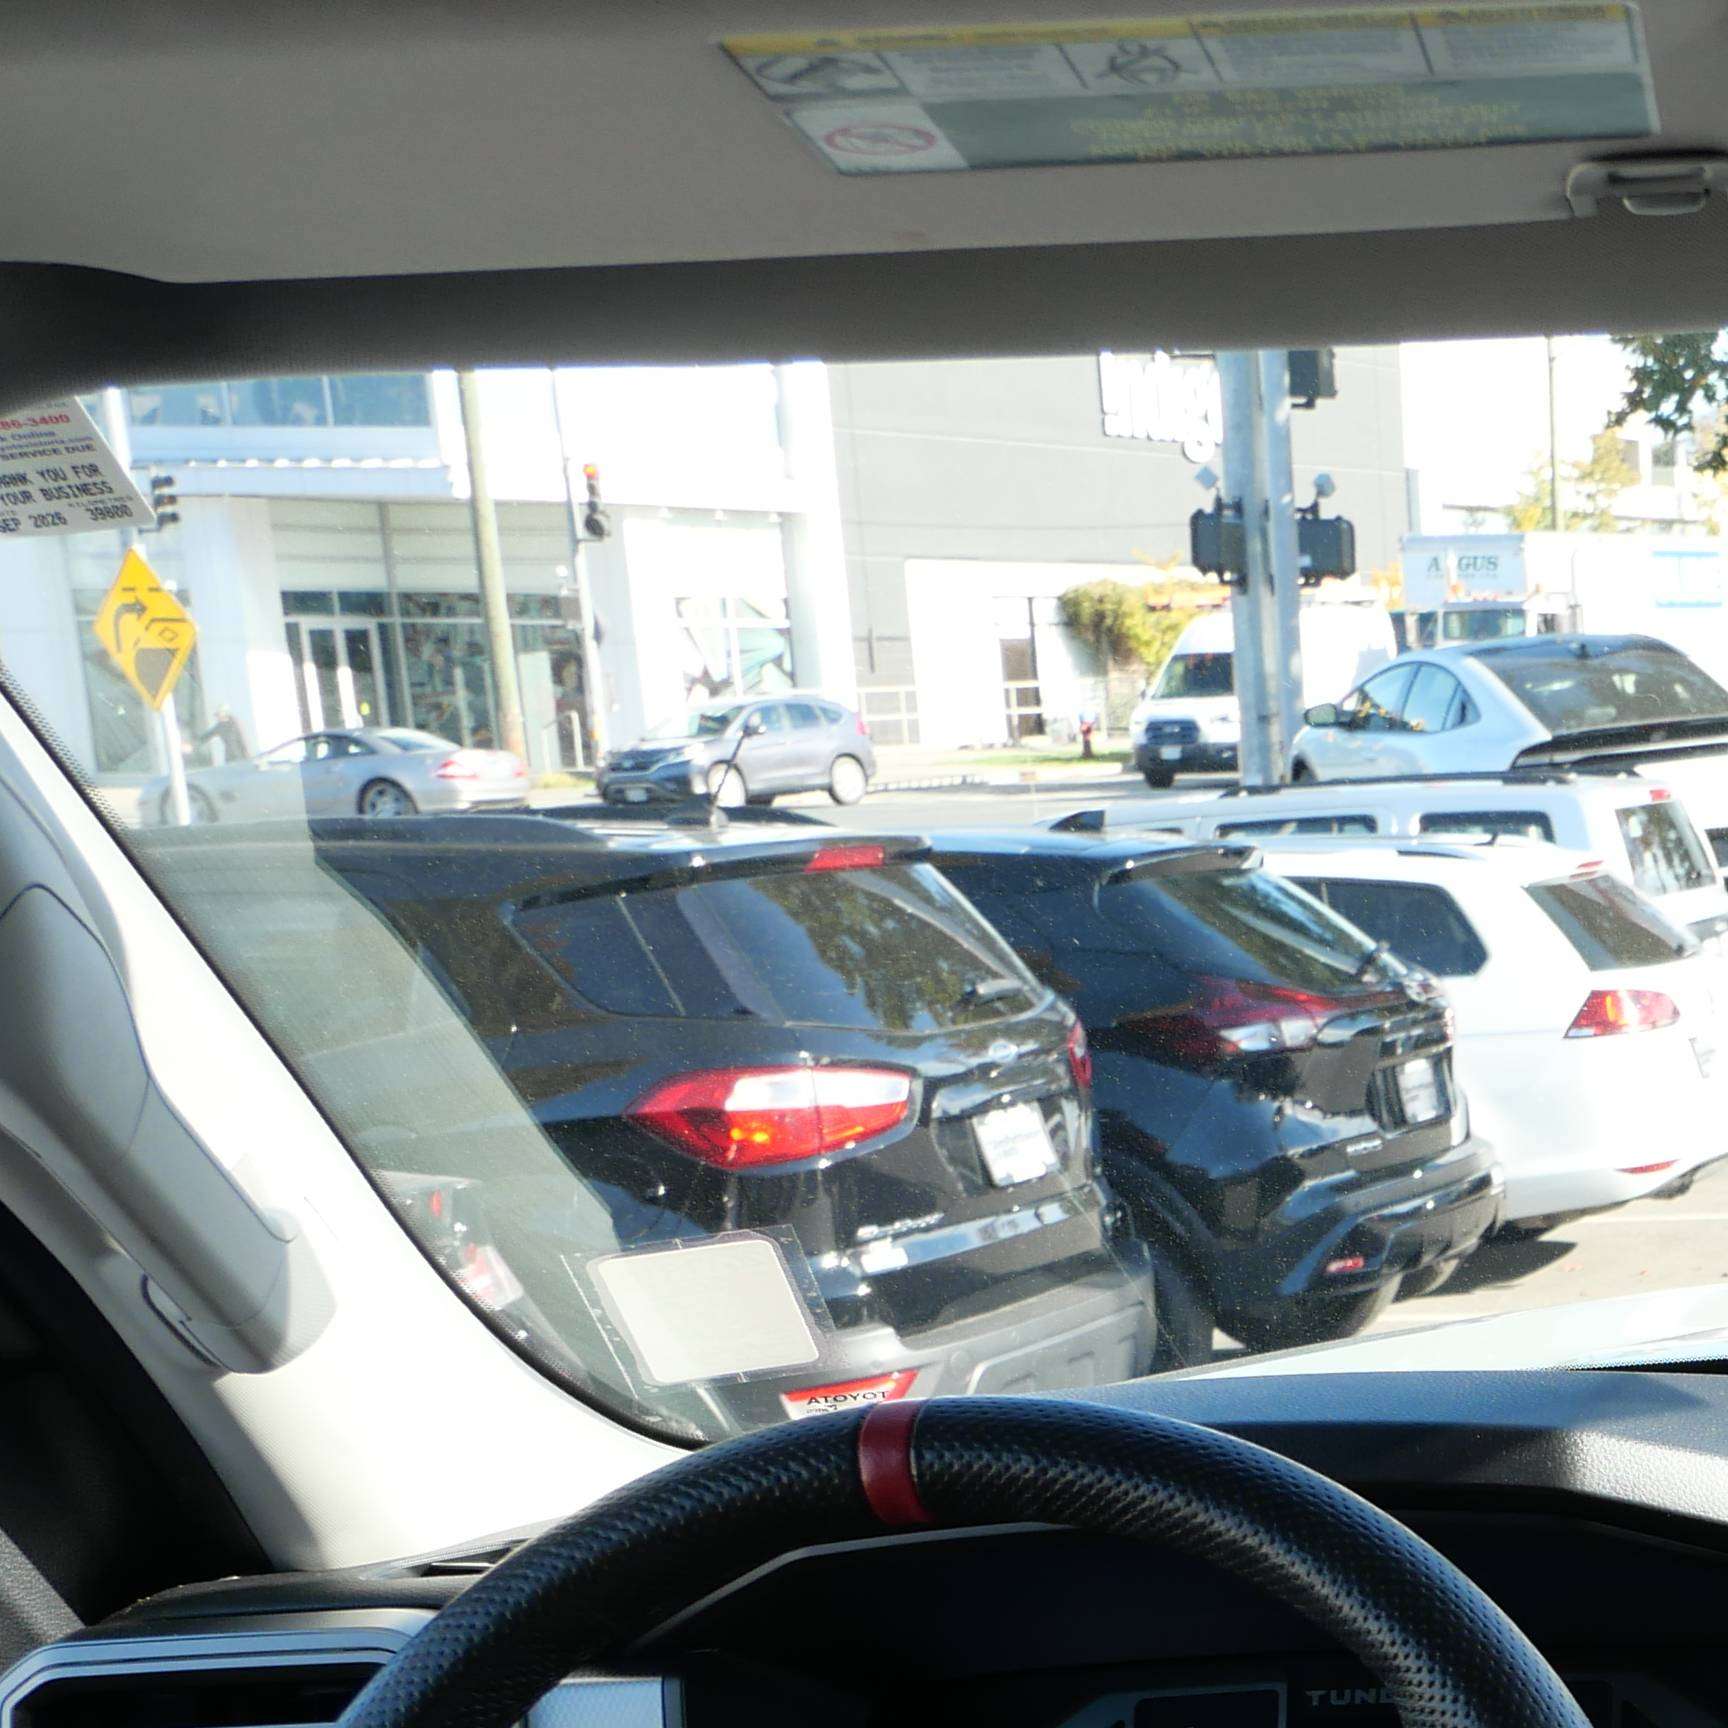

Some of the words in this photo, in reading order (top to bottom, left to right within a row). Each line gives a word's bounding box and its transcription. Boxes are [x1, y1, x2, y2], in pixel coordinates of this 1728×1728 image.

[1, 447, 62, 460] SERVICE
[64, 443, 95, 454] DUE
[0, 472, 32, 488] HANK
[36, 467, 68, 482] YOU
[71, 463, 103, 479] FOR
[0, 489, 36, 507] YOUR
[40, 481, 114, 501] BUSINESS
[0, 517, 22, 533] SEP
[1427, 556, 1498, 572] AGUS
[1305, 1688, 1399, 1707] TUN
